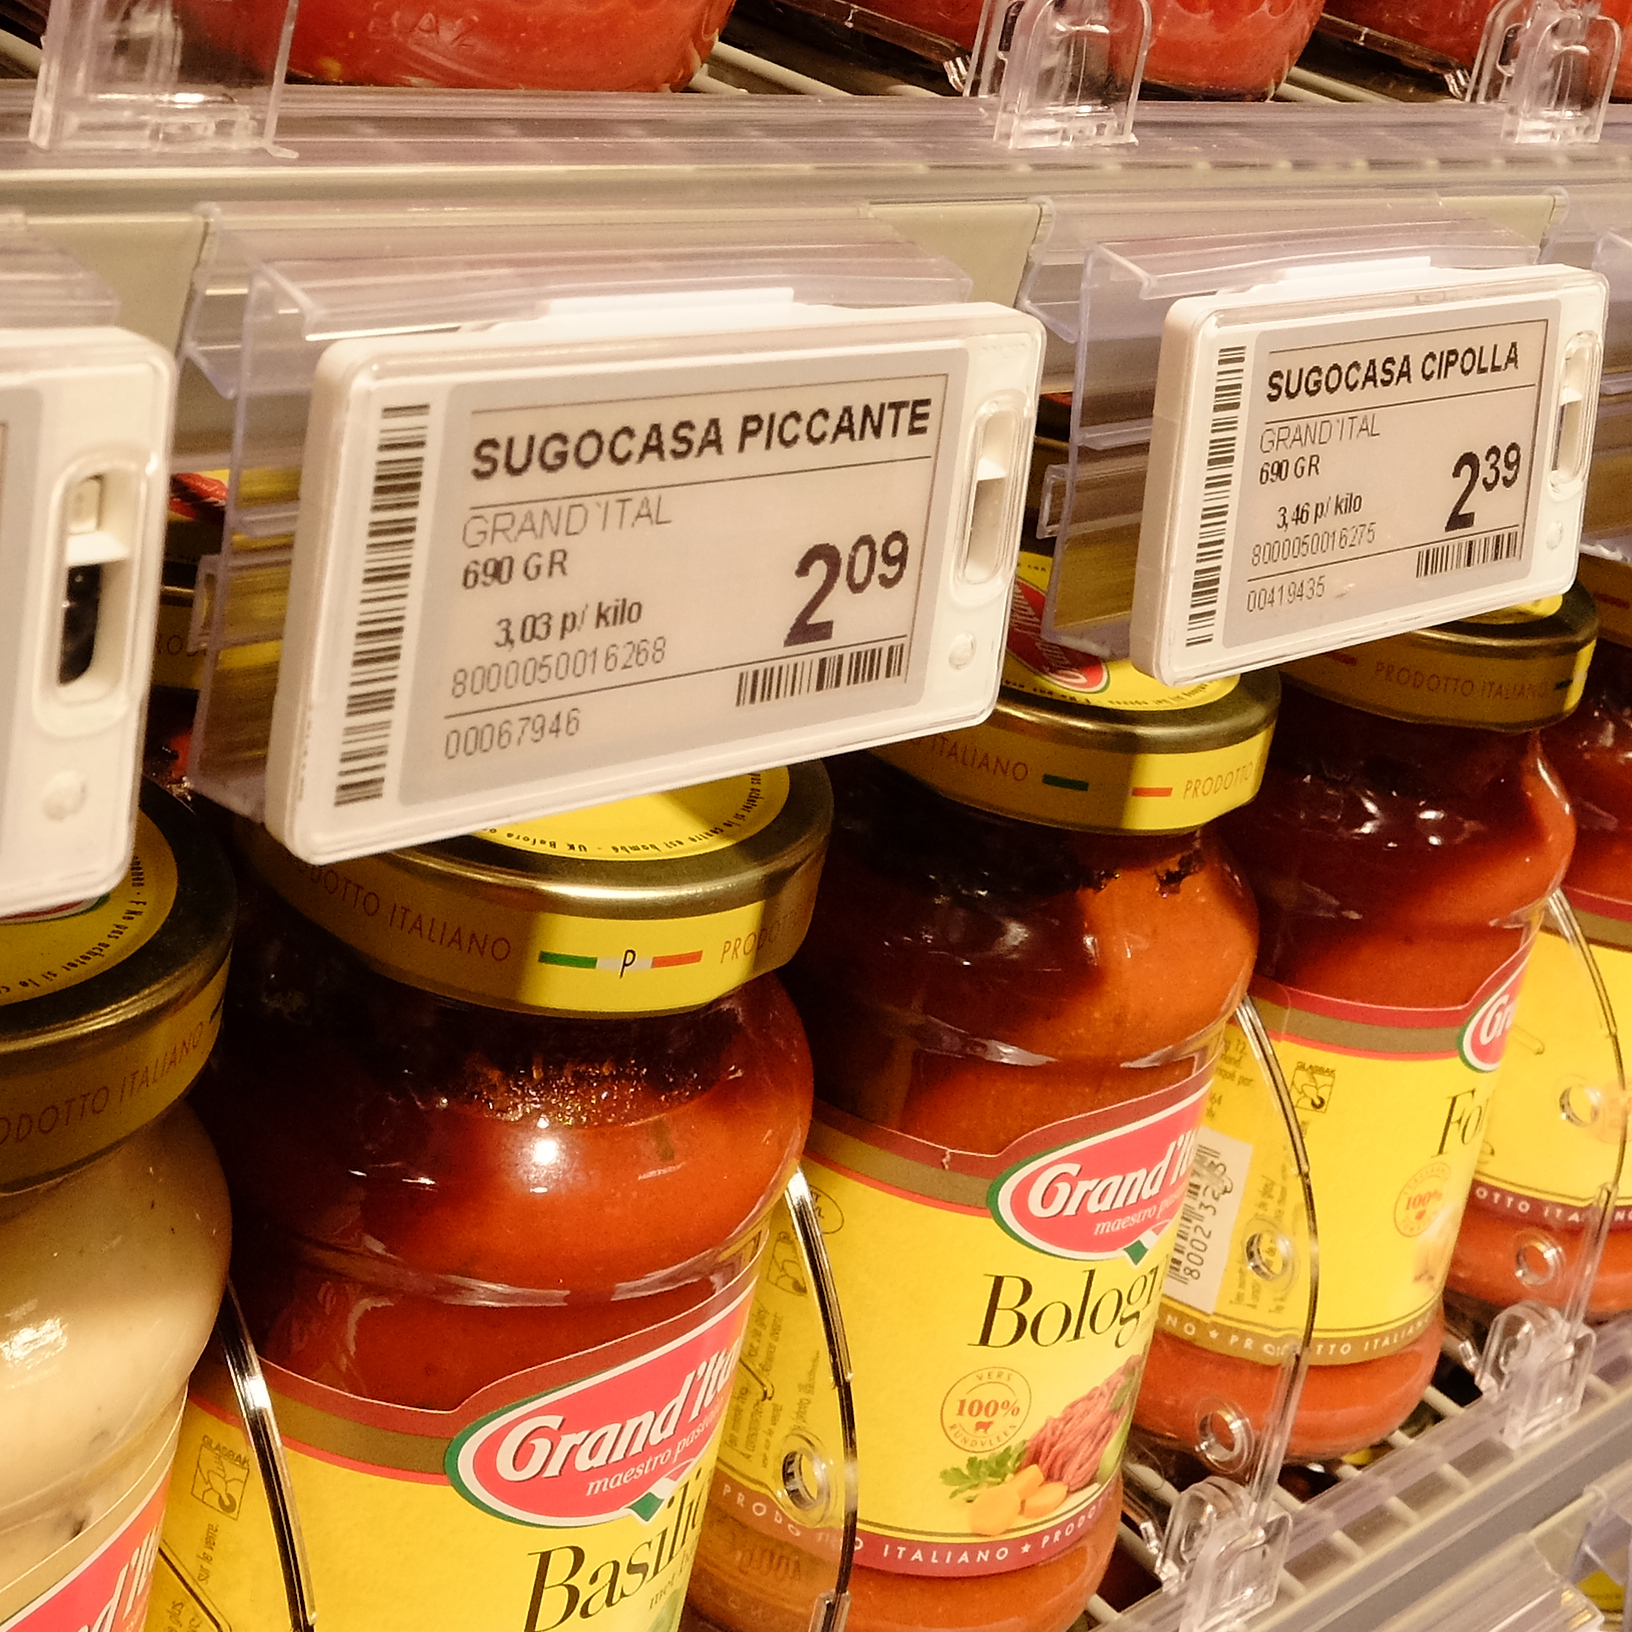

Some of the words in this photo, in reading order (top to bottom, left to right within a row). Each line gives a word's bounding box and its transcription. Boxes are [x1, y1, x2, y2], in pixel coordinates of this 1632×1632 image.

[1265, 353, 1414, 404] SUGOCASA
[1420, 340, 1520, 382] CIPOLLA
[470, 416, 725, 482] SUGOCASA
[736, 398, 934, 457] PICCANTE
[1258, 459, 1291, 487] 690
[1292, 453, 1321, 481] GR
[1276, 501, 1312, 533] 3,46
[1333, 491, 1364, 518] kilo
[460, 555, 514, 592] 690
[522, 548, 569, 582] GR
[1246, 574, 1327, 615] 00419435
[493, 614, 554, 651] 3,03
[594, 599, 644, 630] kilo
[450, 635, 668, 701] 8000050016268
[443, 708, 582, 761] 00067946
[929, 734, 1030, 783] ITALIANO
[387, 898, 512, 963] ITALIANO
[618, 949, 638, 978] P
[1093, 1204, 1158, 1237] maestro
[973, 1368, 1016, 1385] VERS
[954, 1394, 1021, 1421] 100%
[585, 1446, 673, 1497] maestro
[882, 1543, 1012, 1566] ITALIANO
